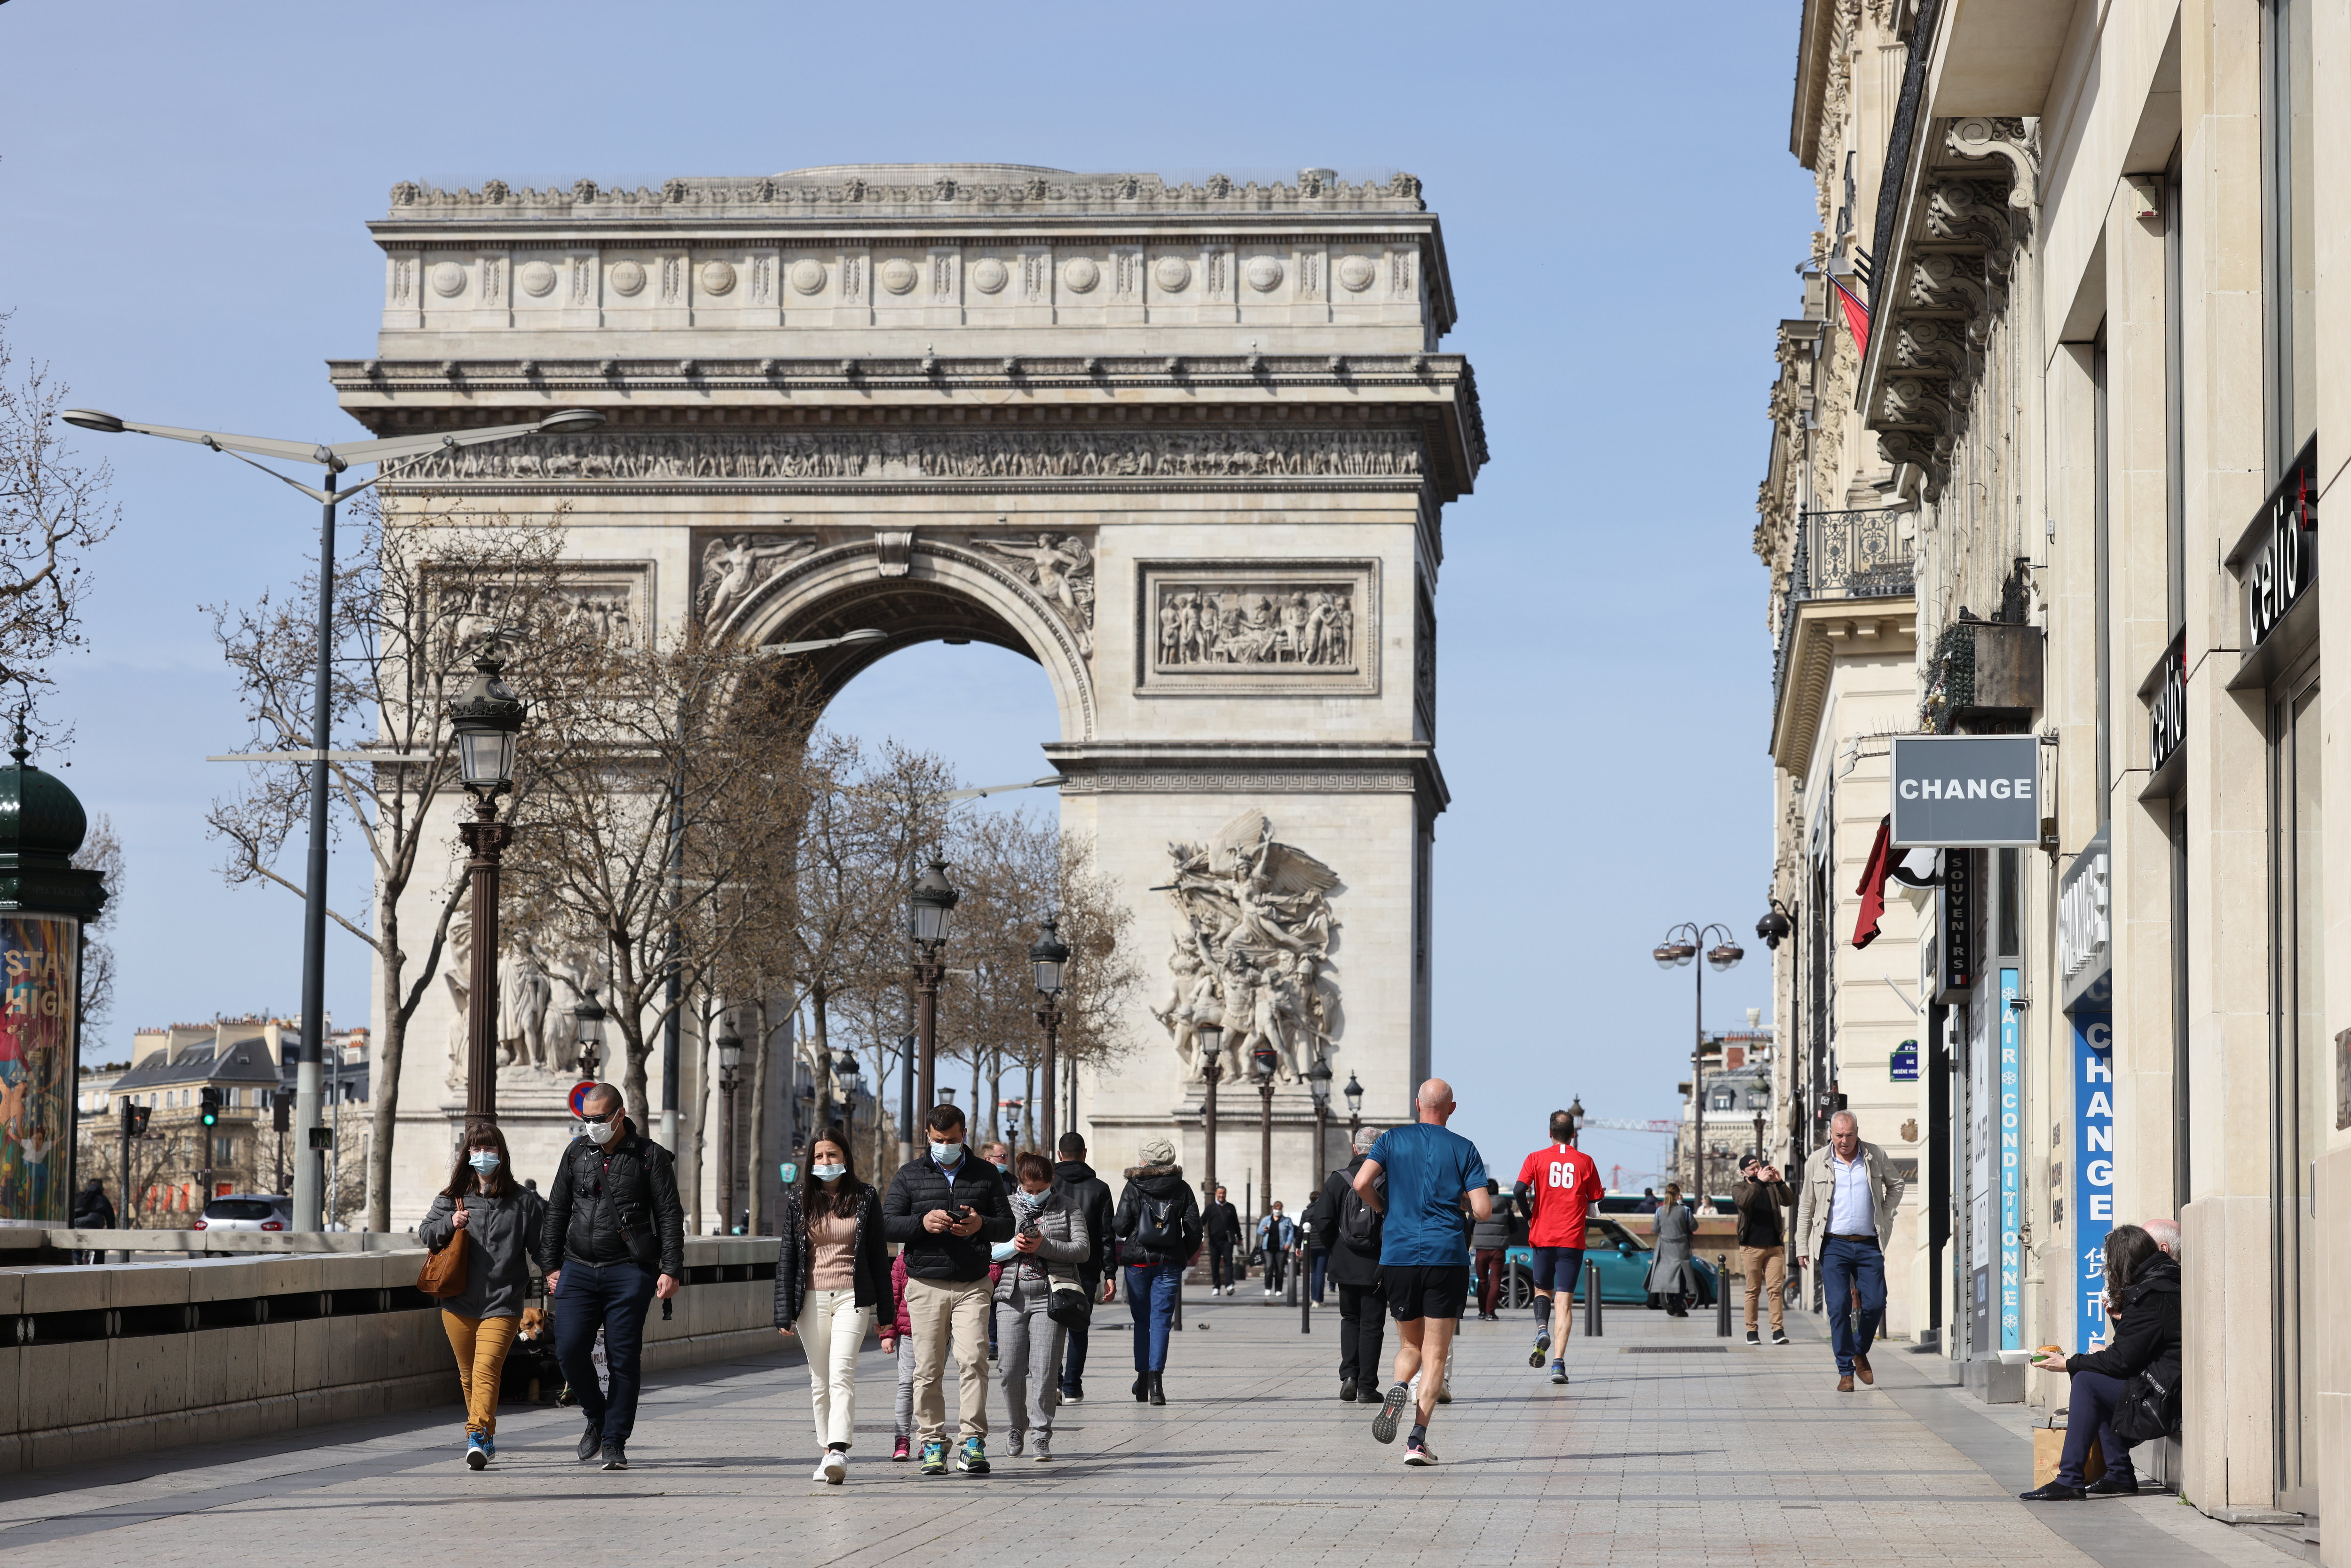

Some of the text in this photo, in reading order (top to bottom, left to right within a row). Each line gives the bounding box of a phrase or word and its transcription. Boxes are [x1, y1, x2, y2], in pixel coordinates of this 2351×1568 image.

[2250, 496, 2298, 646] celio
[2151, 654, 2182, 771] celio
[1900, 779, 2032, 800] CHANGE
[6, 950, 71, 980] STAY
[1951, 858, 1964, 969] SOUVENIRS
[2058, 854, 2109, 981] CHANGE
[5, 988, 71, 1017] HIGH
[1549, 1161, 1574, 1189] 66
[1975, 1115, 1988, 1163] LOUER
[2002, 1009, 2017, 1306] AIR CONDITIONNE
[2086, 1023, 2113, 1221] CHANGE
